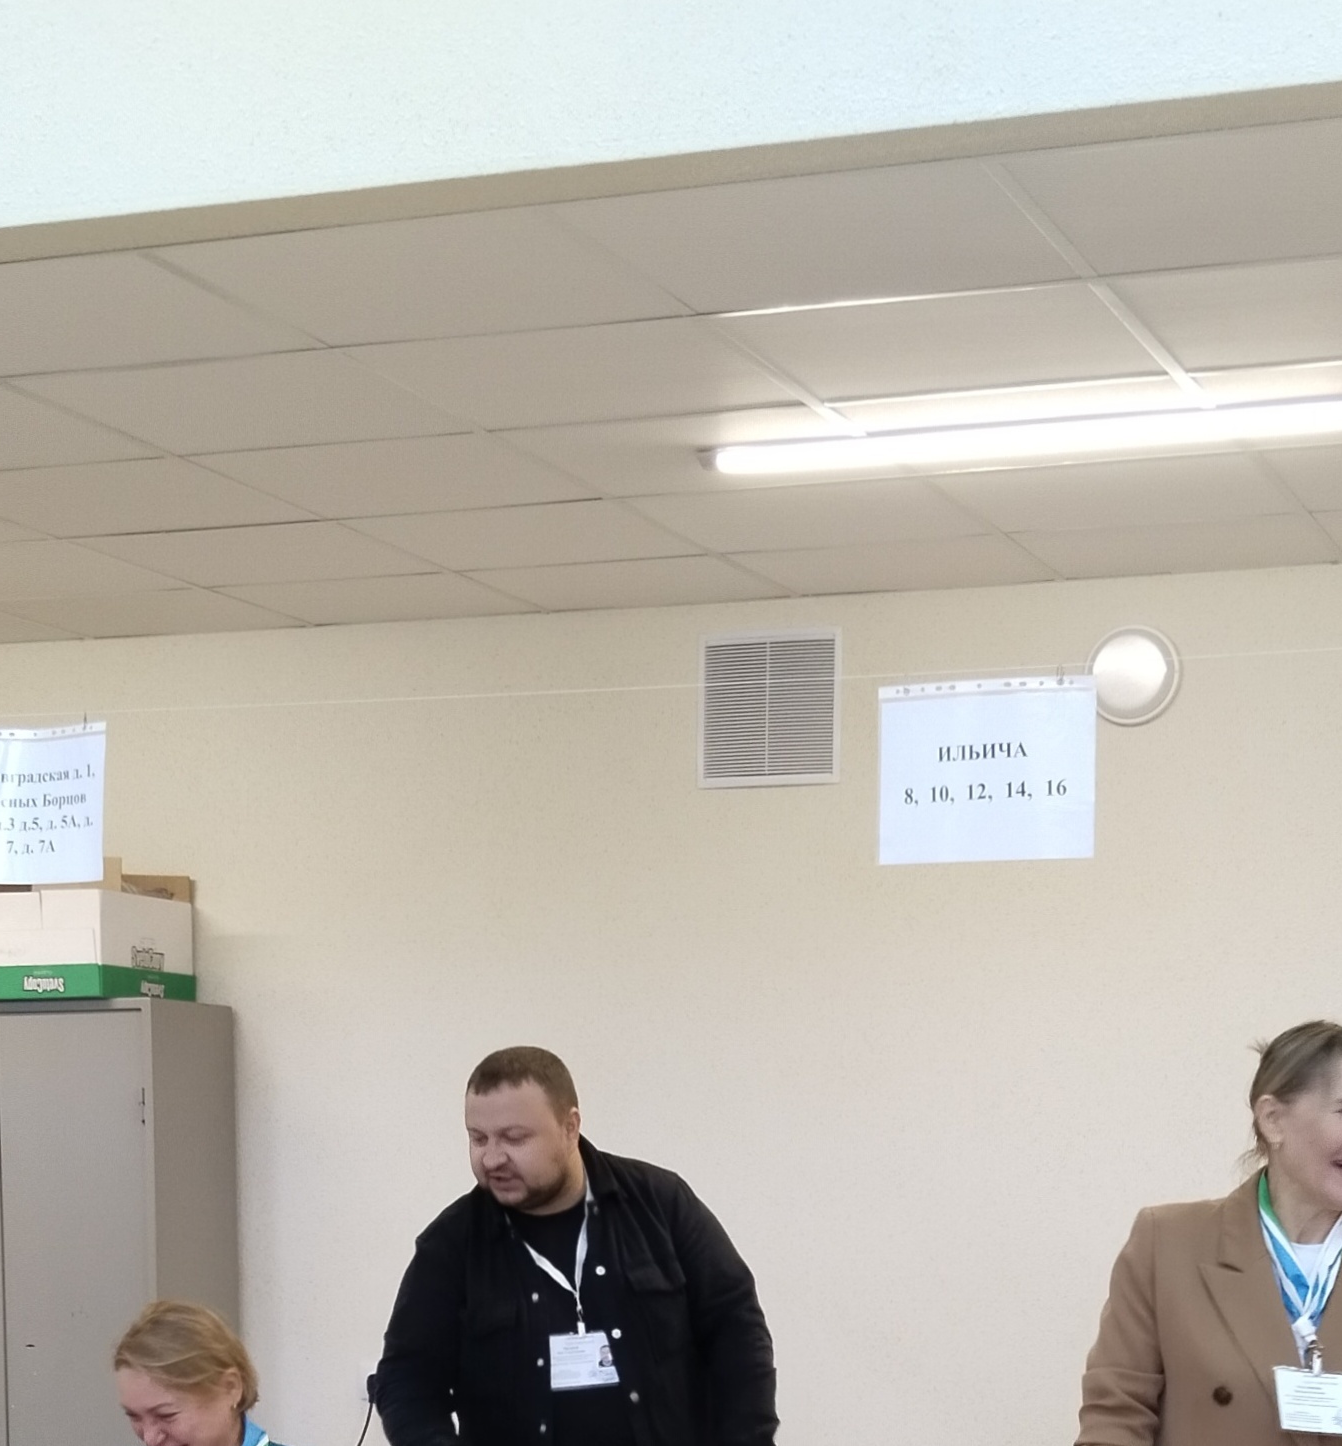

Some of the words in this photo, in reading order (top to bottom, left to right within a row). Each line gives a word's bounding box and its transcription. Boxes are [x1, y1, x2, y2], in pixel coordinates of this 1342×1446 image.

[937, 741, 1029, 762] ИЛЬИЧА
[42, 793, 87, 809] Борцов
[904, 787, 919, 806] 8,
[930, 785, 955, 805] 10,
[967, 783, 993, 802] 12,
[1005, 780, 1033, 800] 14,
[1046, 778, 1067, 797] 16
[6, 840, 18, 855] 7,
[38, 840, 56, 853] 7А
